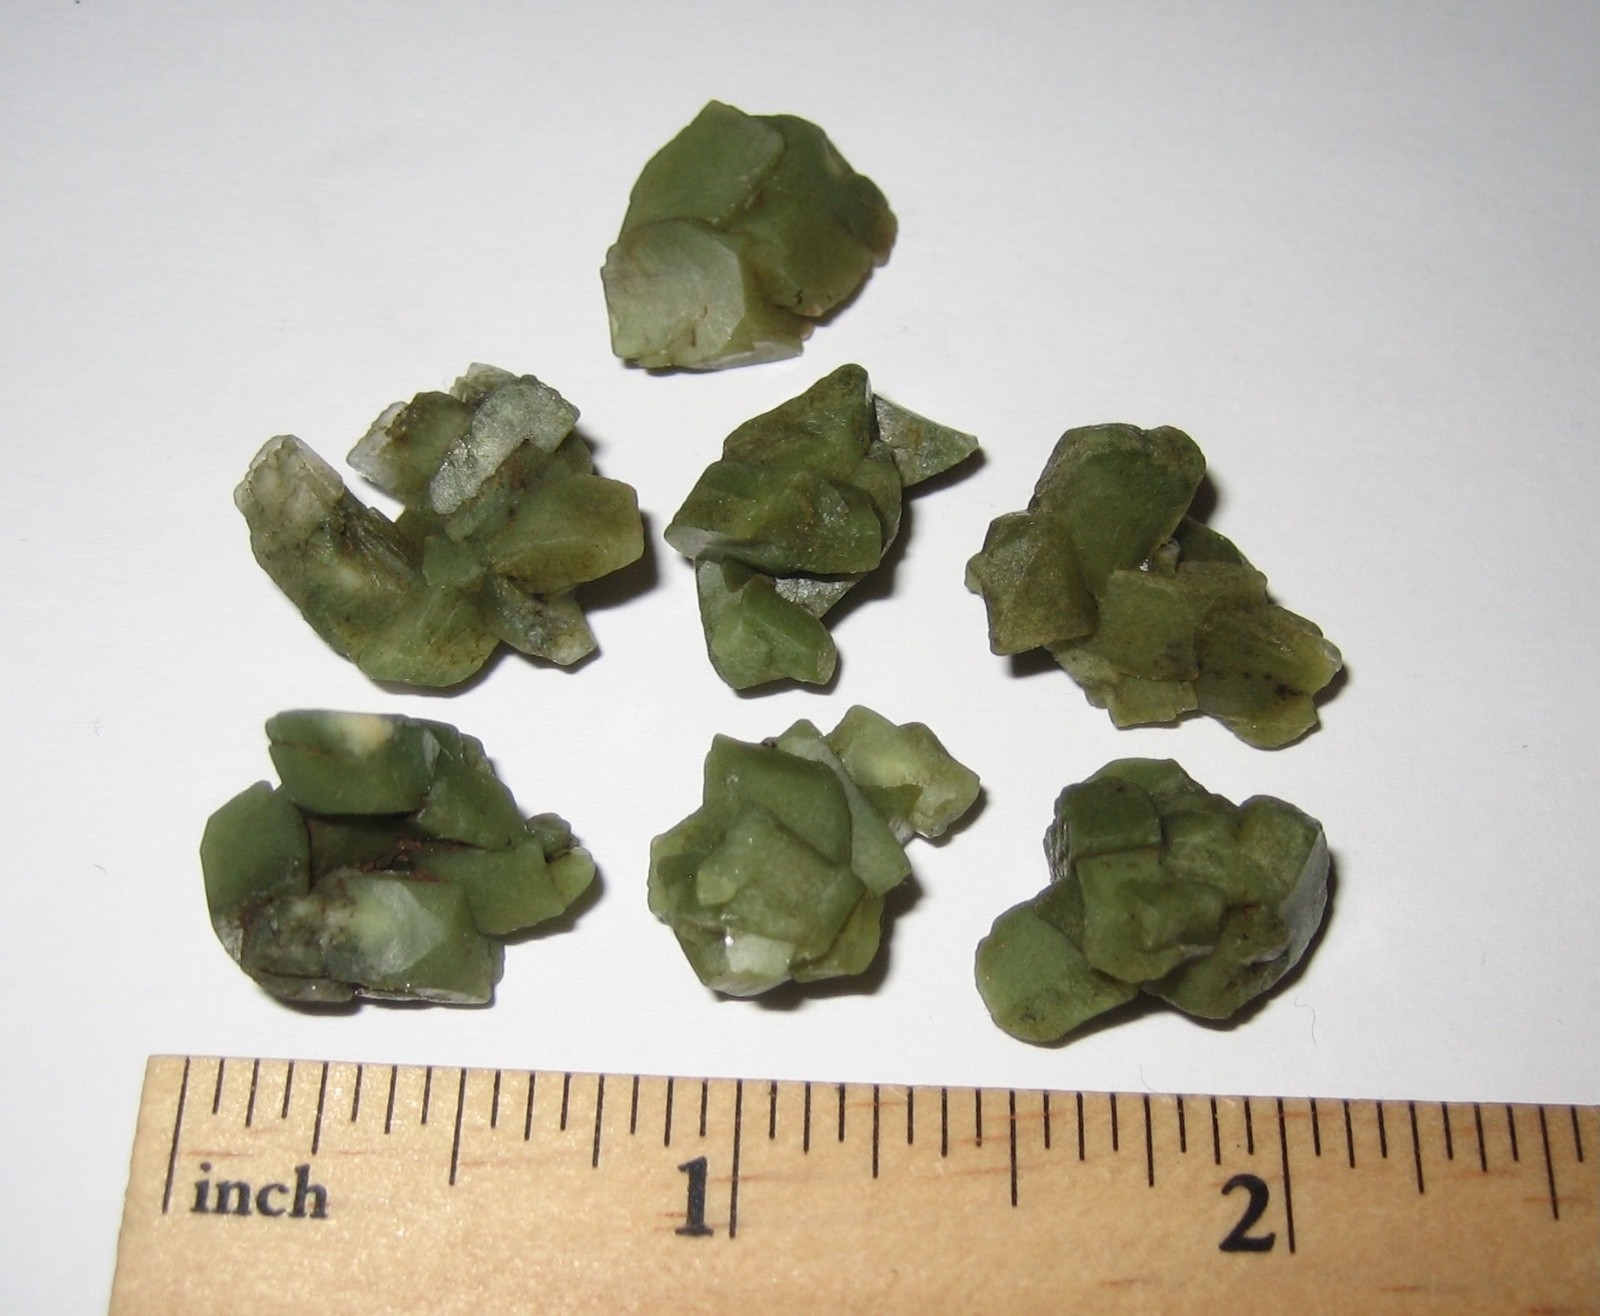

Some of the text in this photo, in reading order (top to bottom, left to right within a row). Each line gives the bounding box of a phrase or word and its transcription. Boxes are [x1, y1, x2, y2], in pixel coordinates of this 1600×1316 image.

[190, 1164, 328, 1219] inch
[674, 1157, 714, 1238] 1
[1218, 1173, 1277, 1254] 2
